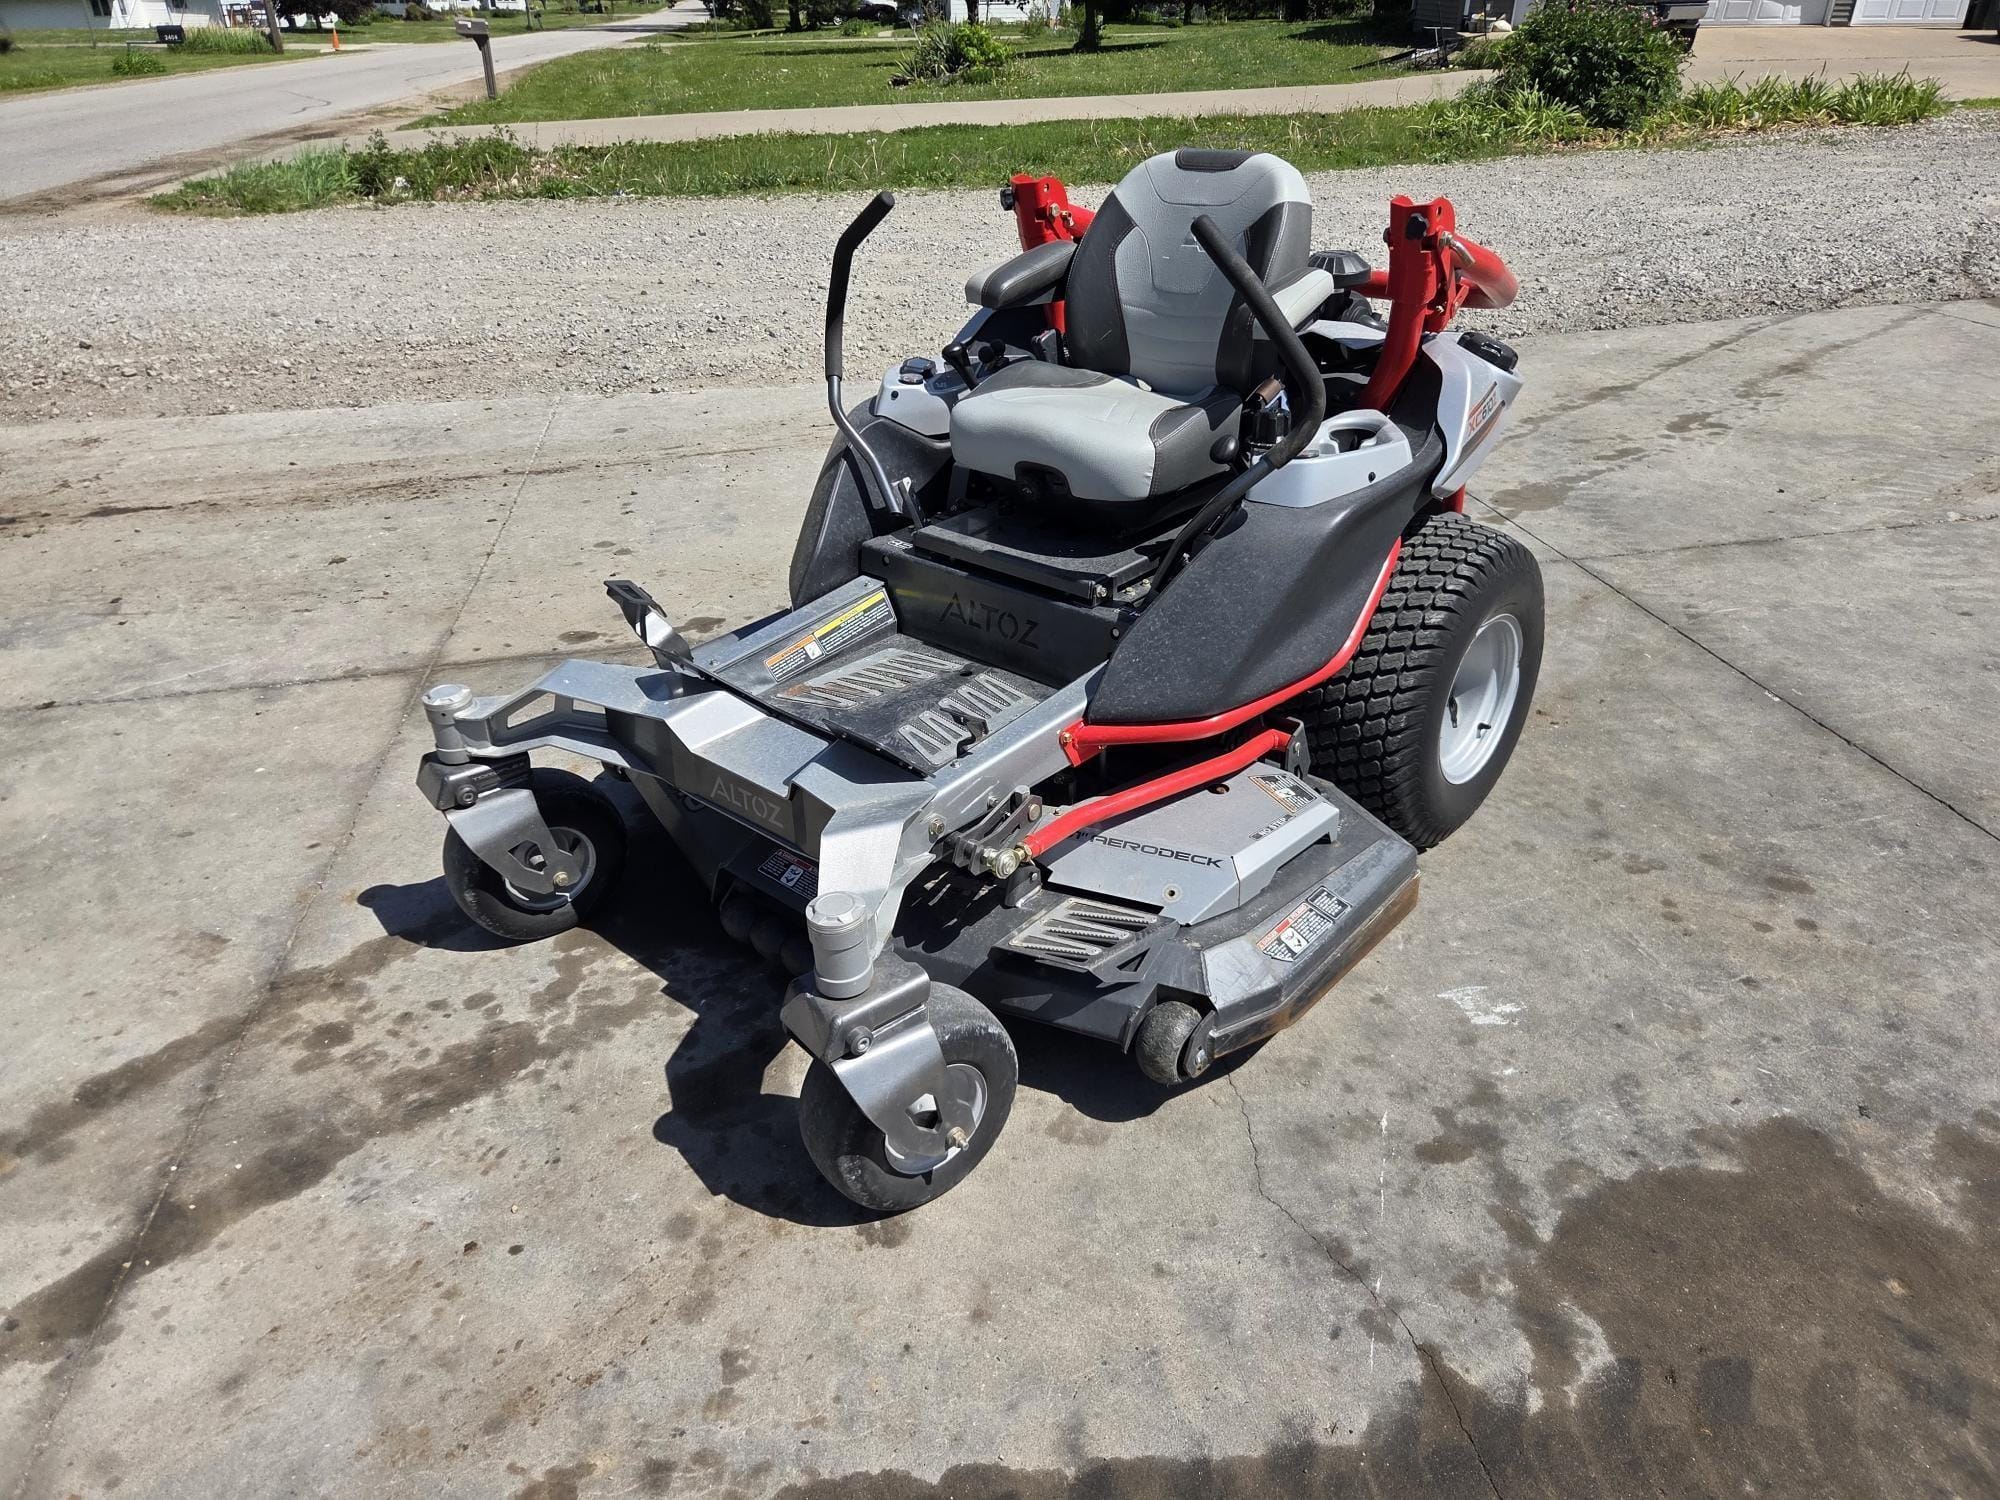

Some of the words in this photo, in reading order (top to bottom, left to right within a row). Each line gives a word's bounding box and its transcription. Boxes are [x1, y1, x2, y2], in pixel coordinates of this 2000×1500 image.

[940, 591, 1040, 650] ALTOZ
[710, 776, 784, 829] ALTOZ
[1090, 834, 1224, 869] AERODECK
